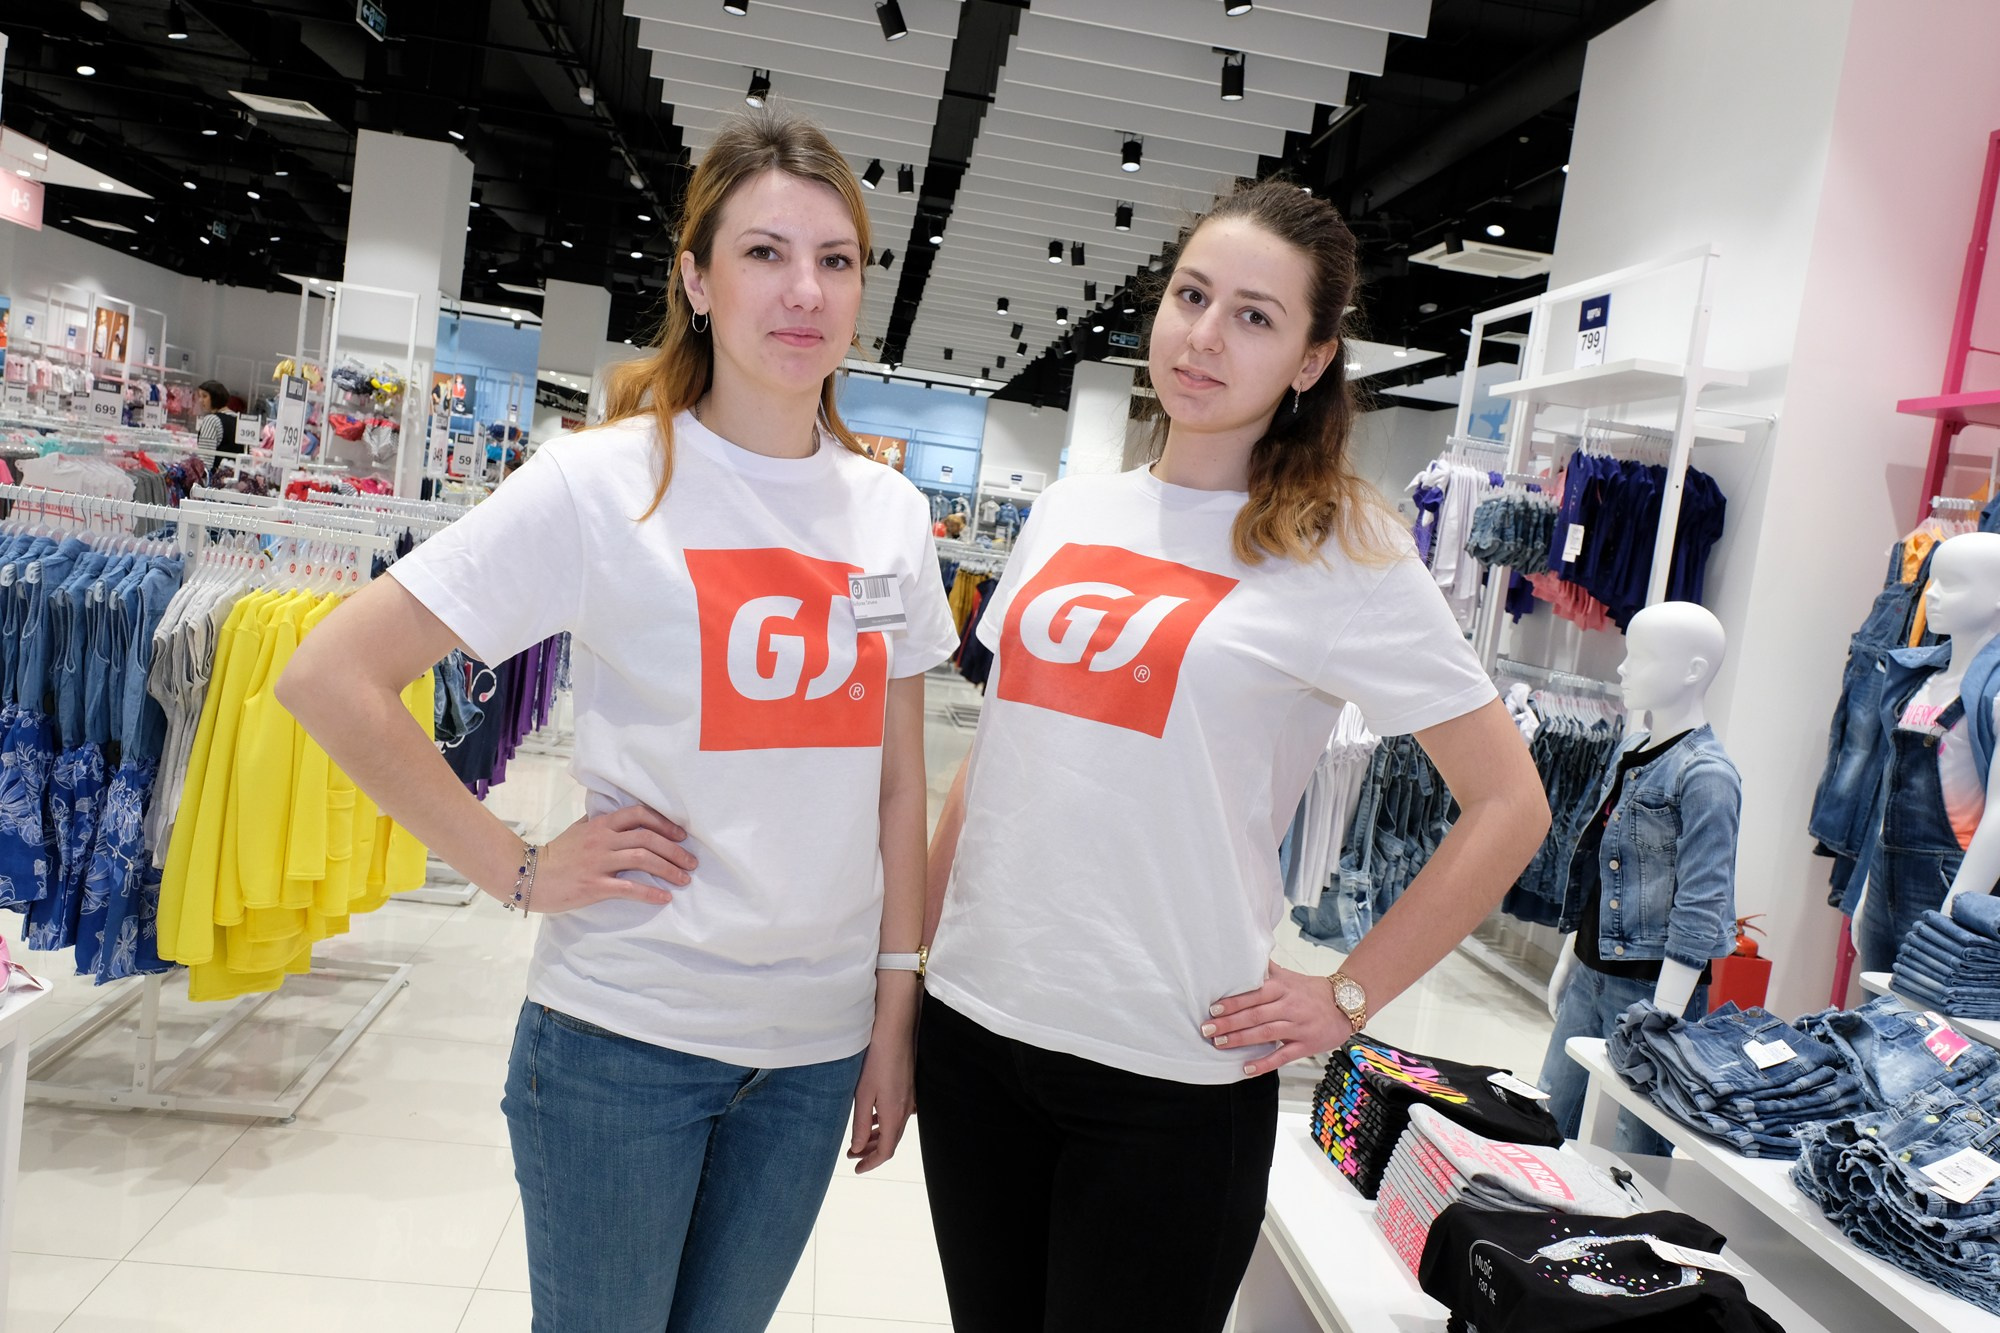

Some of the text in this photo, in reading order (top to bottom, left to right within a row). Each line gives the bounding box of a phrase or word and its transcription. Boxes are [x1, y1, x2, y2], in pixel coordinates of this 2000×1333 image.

[11, 187, 31, 212] 0-5
[1582, 331, 1600, 351] 799
[94, 403, 117, 416] 699
[240, 429, 256, 438] 399
[282, 425, 299, 446] 799
[1019, 581, 1191, 673] GJ
[727, 594, 858, 701] GJ
